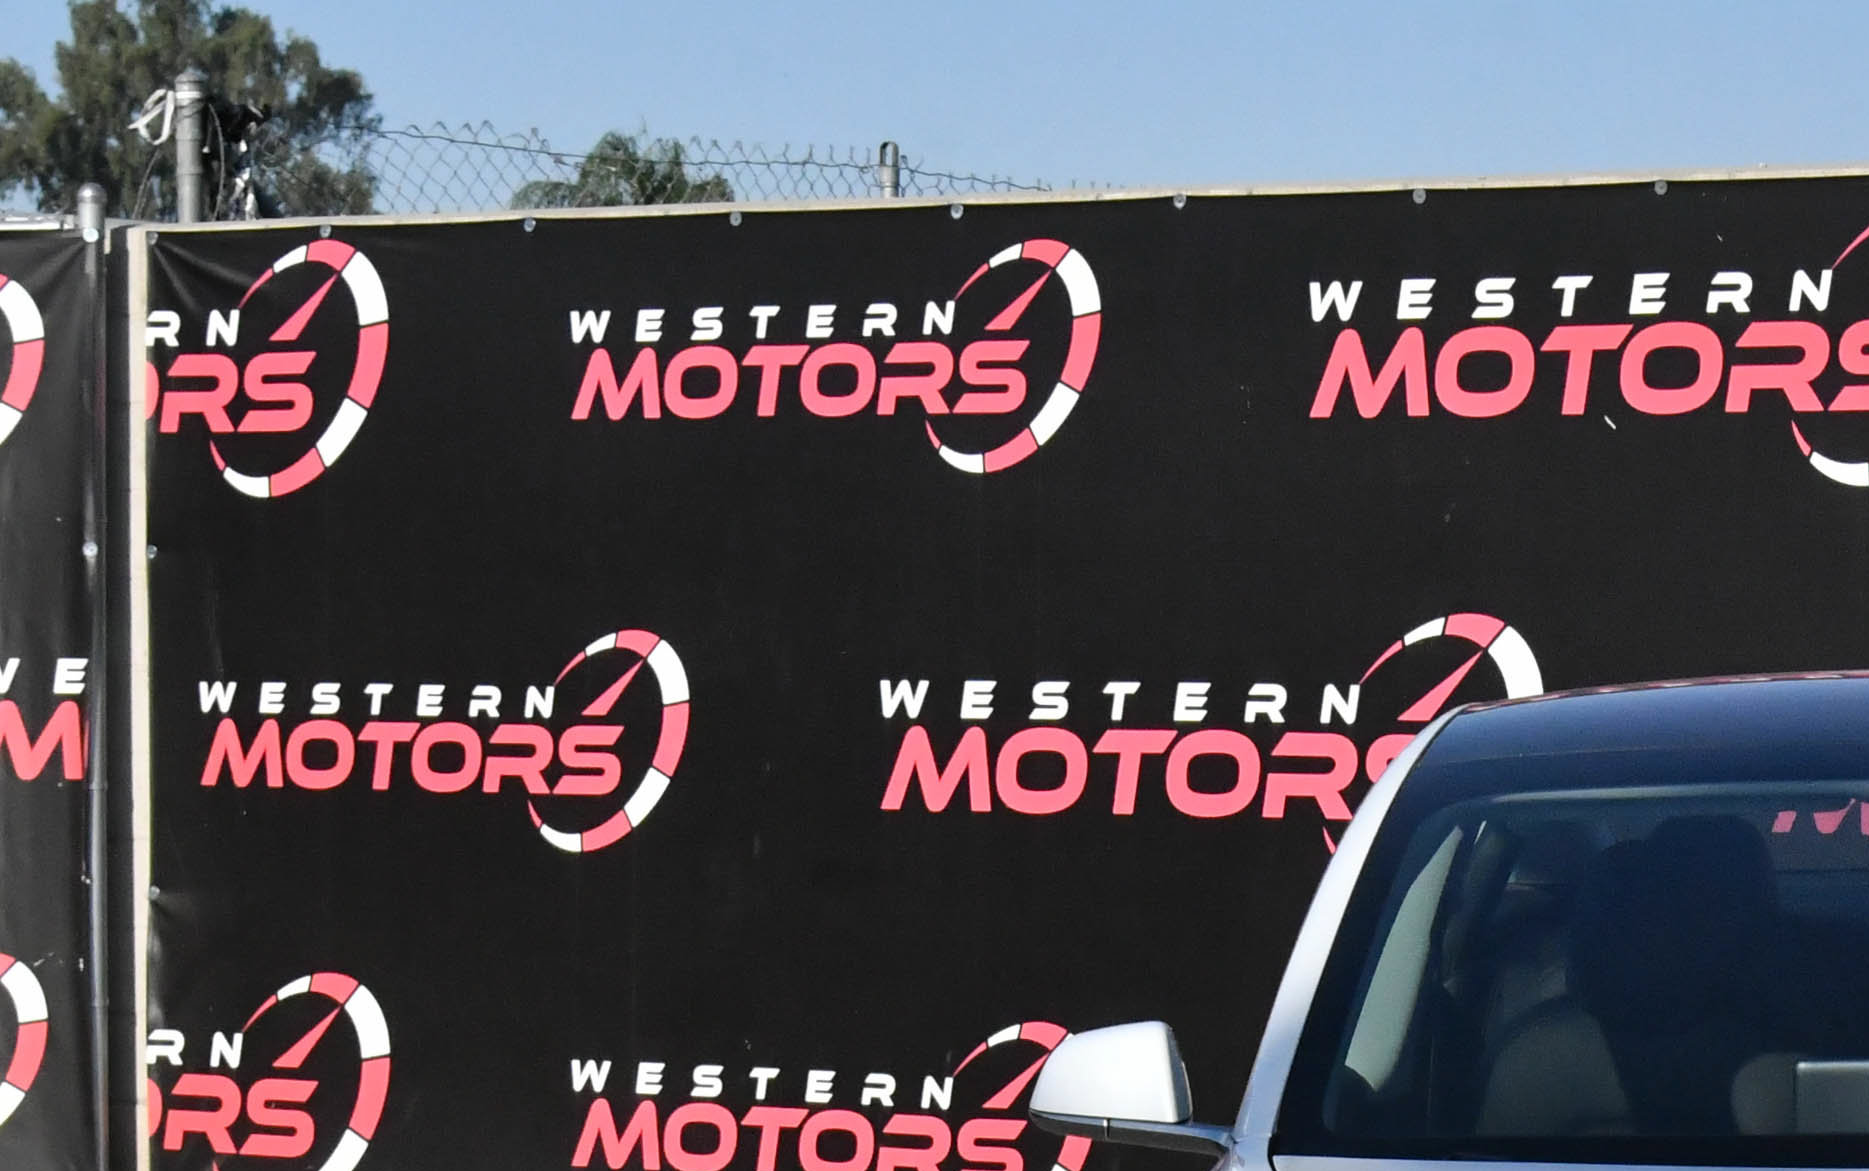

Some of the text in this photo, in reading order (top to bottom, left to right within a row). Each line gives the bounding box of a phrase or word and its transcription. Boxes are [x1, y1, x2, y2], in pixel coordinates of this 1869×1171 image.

[1310, 269, 1832, 322] WESTERN
[570, 301, 956, 344] WESTERN
[571, 340, 1031, 420] MOTORS
[199, 681, 555, 718] WESTERN
[879, 680, 1361, 724] WESTERN
[200, 718, 625, 795] MOTORS
[570, 1058, 954, 1111] WESTERN
